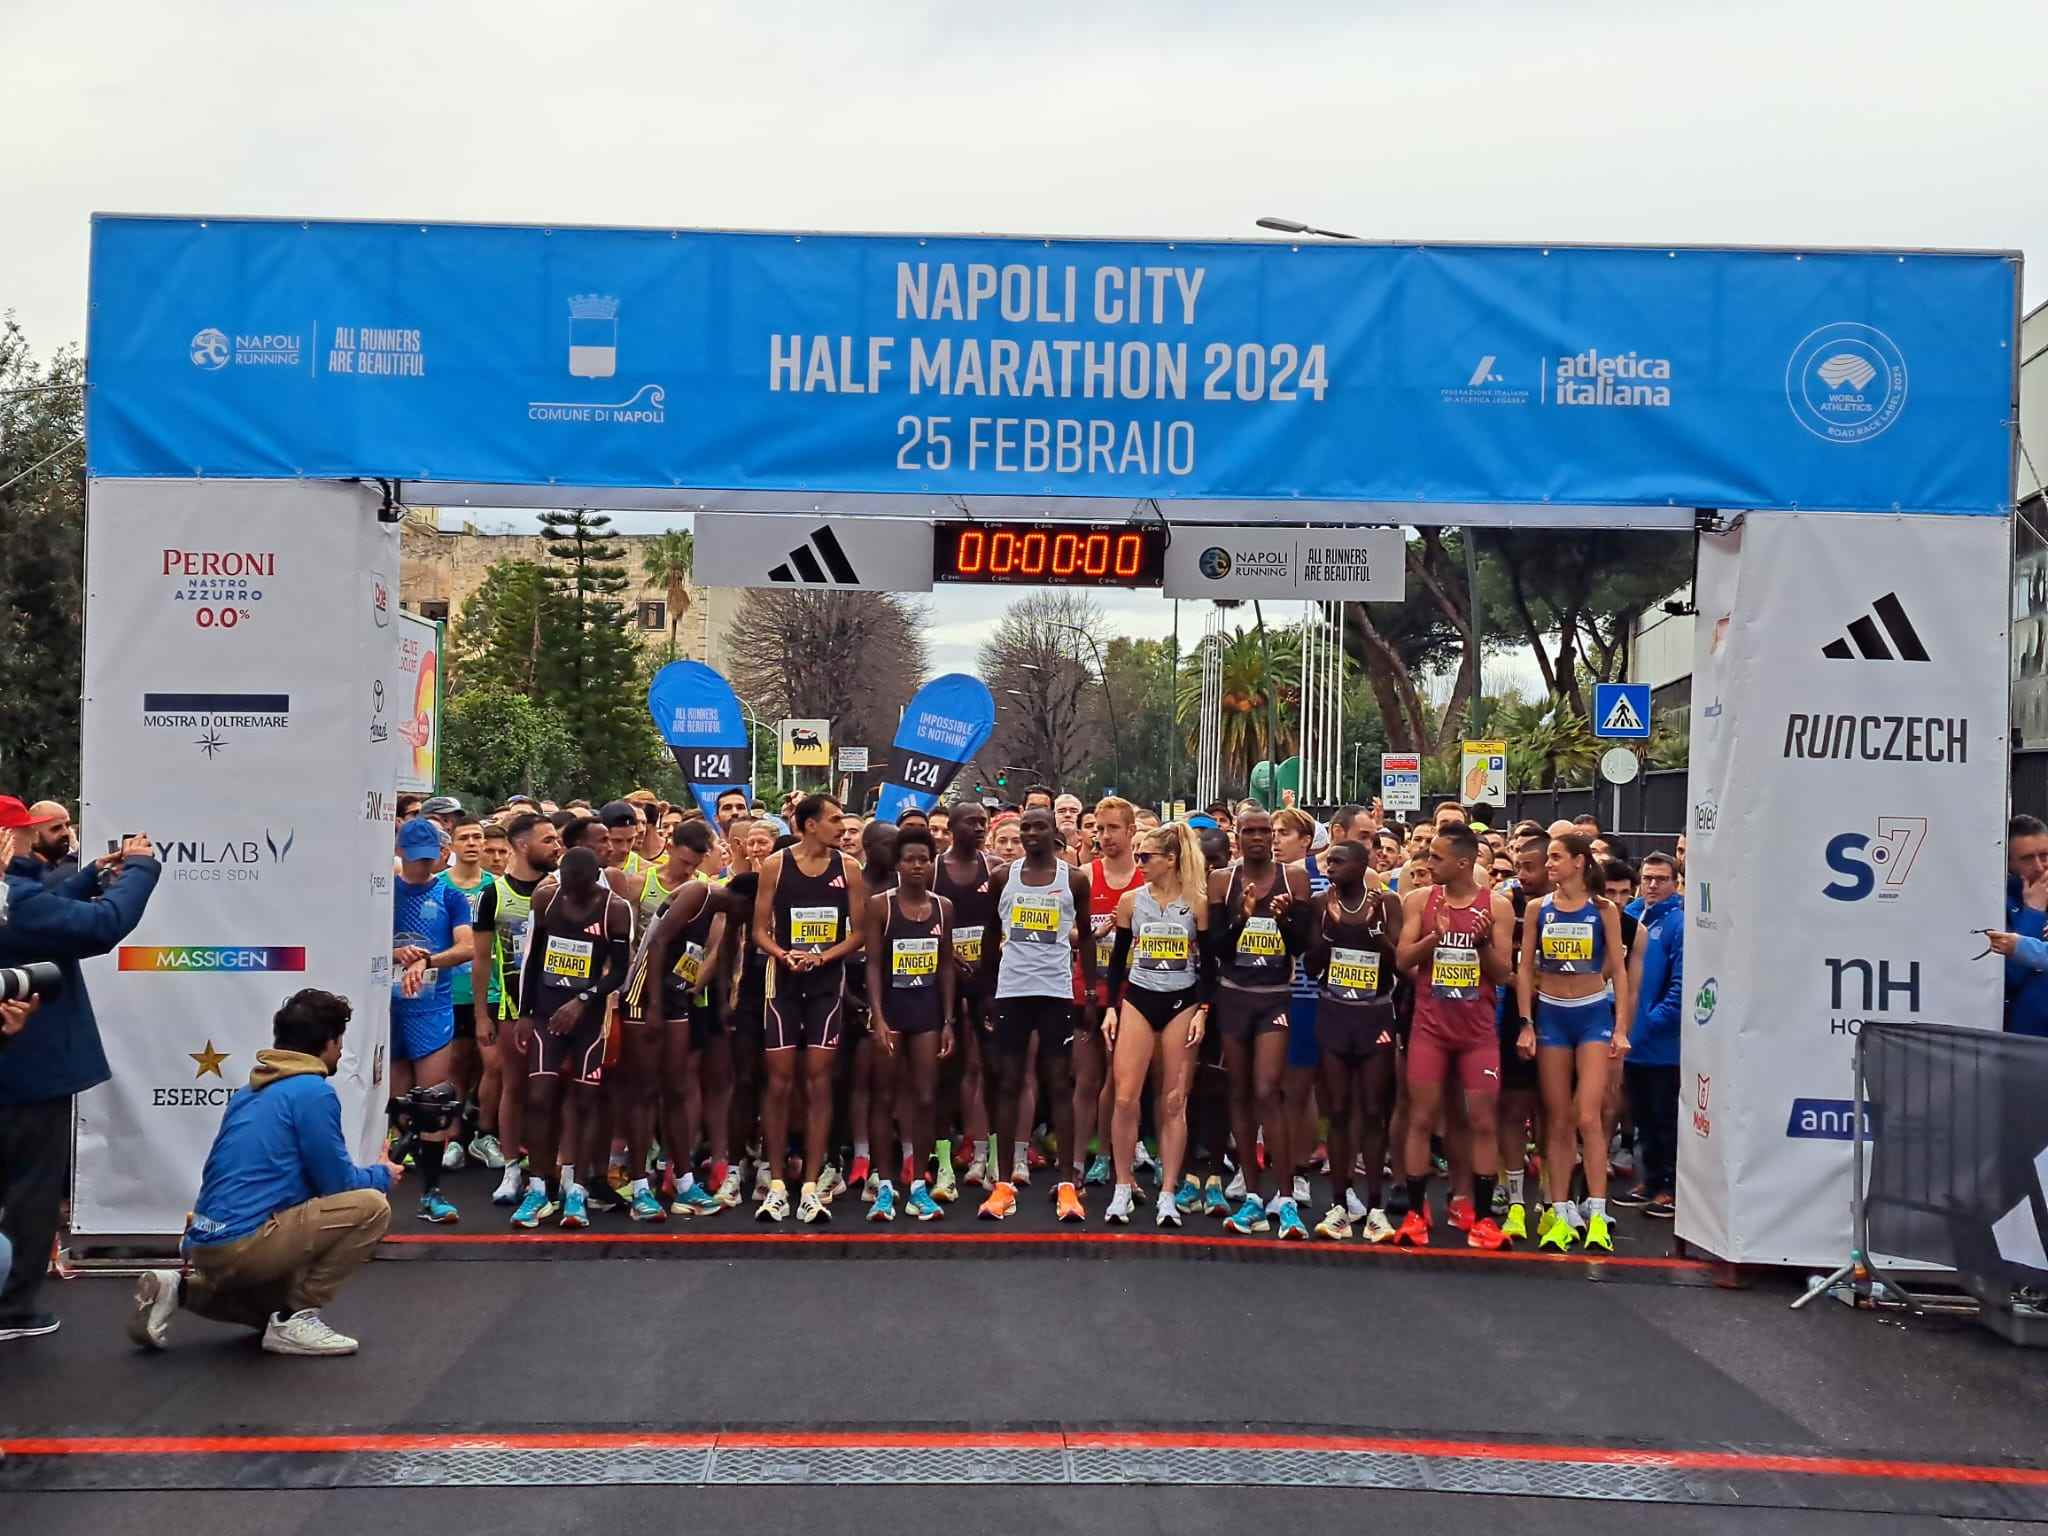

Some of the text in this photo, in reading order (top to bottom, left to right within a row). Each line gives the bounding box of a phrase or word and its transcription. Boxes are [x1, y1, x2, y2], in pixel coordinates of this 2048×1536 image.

[896, 263, 1206, 325] NAPOLI CITY
[236, 335, 300, 350] NAPOLI
[335, 327, 421, 353] ALL RUNNERS
[236, 353, 300, 366] RUNNING
[329, 350, 425, 377] ARE BEAUTIFUL
[769, 333, 1329, 401] HALF MARATHON 2024
[1556, 348, 1671, 380] atletica
[1556, 376, 1671, 406] italiana
[1828, 394, 1865, 403] WORLD
[528, 407, 664, 423] COMUNE DI NAPOLI
[1820, 403, 1874, 412] ATHLETICS
[896, 415, 1196, 475] 25 FEBBRAIO
[958, 532, 1141, 574] 00:00:00
[1236, 552, 1288, 564] NAPOLI
[1307, 548, 1367, 565] ALL RUNNERS
[162, 549, 276, 577] PERONI
[1236, 567, 1288, 577] RUNNING
[1304, 565, 1371, 582] ARE BEAUTIFUL
[188, 579, 248, 588] NASTRO
[174, 590, 263, 601] AZZURRO
[144, 715, 197, 727] MOSTRA
[213, 715, 289, 728] OLTREMARE
[674, 707, 687, 720] ALL
[672, 720, 686, 733] ARE
[919, 711, 975, 735] IMPOSSIBLE
[917, 725, 968, 747] IS NOTHING
[1783, 713, 1968, 764] RUNCZECH
[694, 753, 731, 778] 1:24
[1491, 758, 1501, 769] P
[904, 758, 940, 788] 1:24
[1386, 775, 1394, 786] P
[154, 841, 259, 863] YNLAB
[174, 869, 260, 881] IRCCS SDN
[1020, 910, 1050, 924] BRIAN
[801, 924, 829, 937] EMILE
[1142, 940, 1185, 953] KRISTINA
[1241, 935, 1281, 949] ANTONY
[1552, 941, 1582, 954] SOFIA
[156, 950, 268, 969] MASSIGEN
[547, 954, 586, 971] BENARD
[898, 955, 934, 969] ANGELA
[1330, 965, 1377, 983] CHARLES
[1435, 966, 1477, 980] YASSINE
[1831, 1018, 1863, 1036] HO
[152, 1088, 239, 1106] ESERCI
